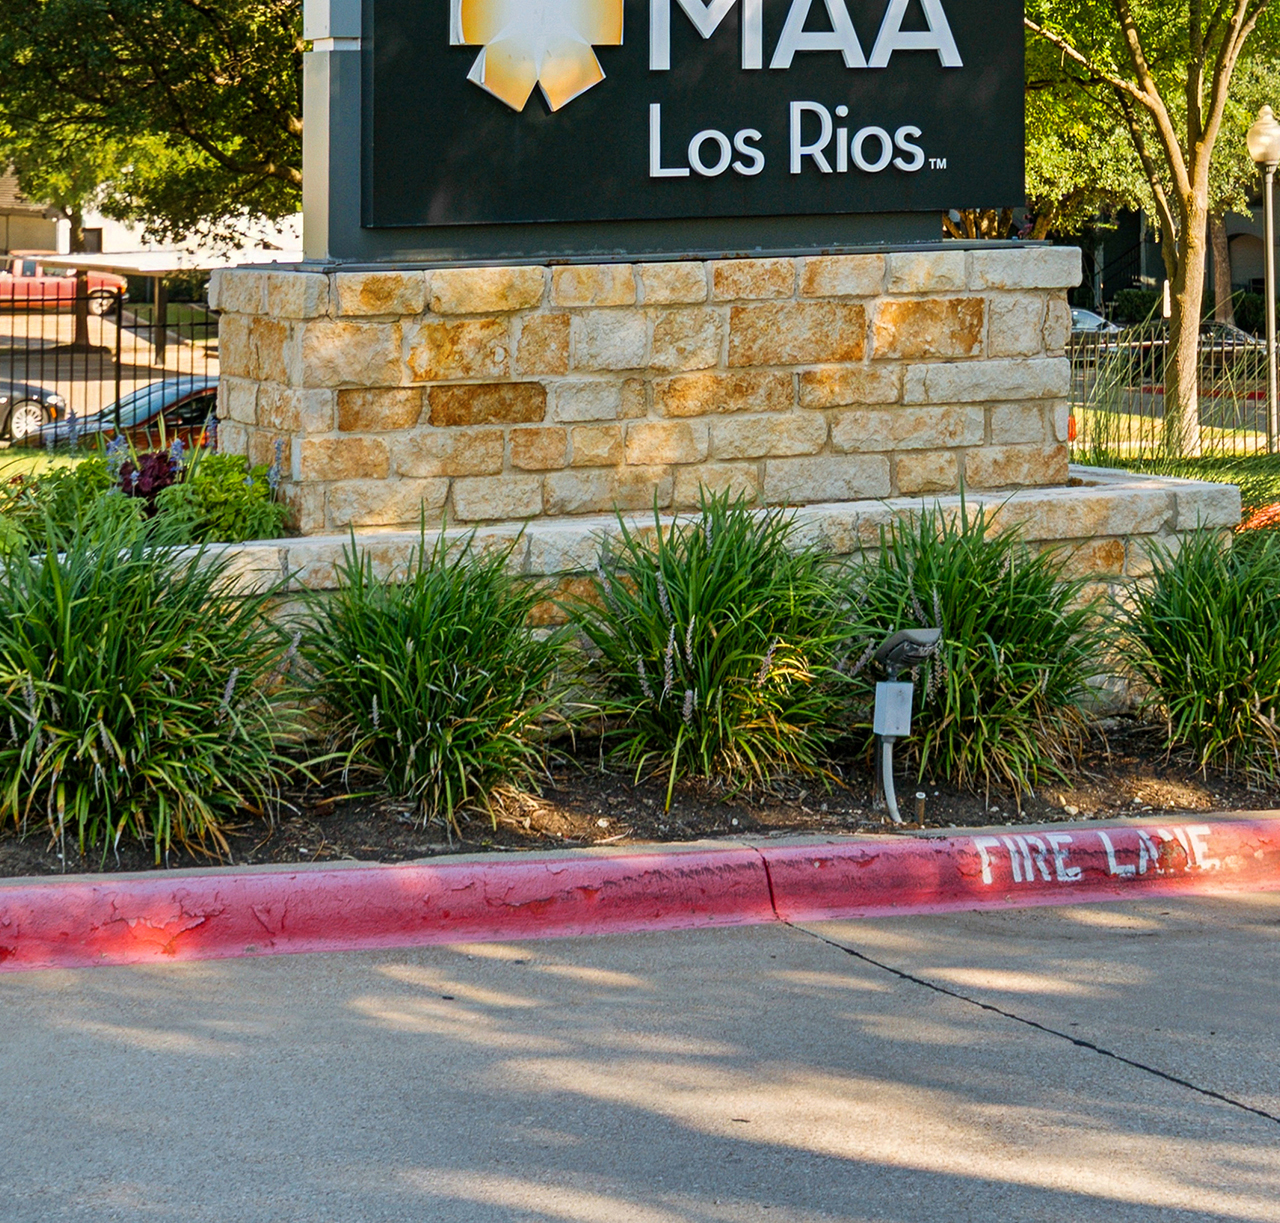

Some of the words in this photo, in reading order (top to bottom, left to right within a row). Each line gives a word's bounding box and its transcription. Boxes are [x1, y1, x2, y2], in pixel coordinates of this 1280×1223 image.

[649, 102, 766, 177] Los
[789, 100, 926, 173] Rios
[974, 834, 1082, 885] FIRE
